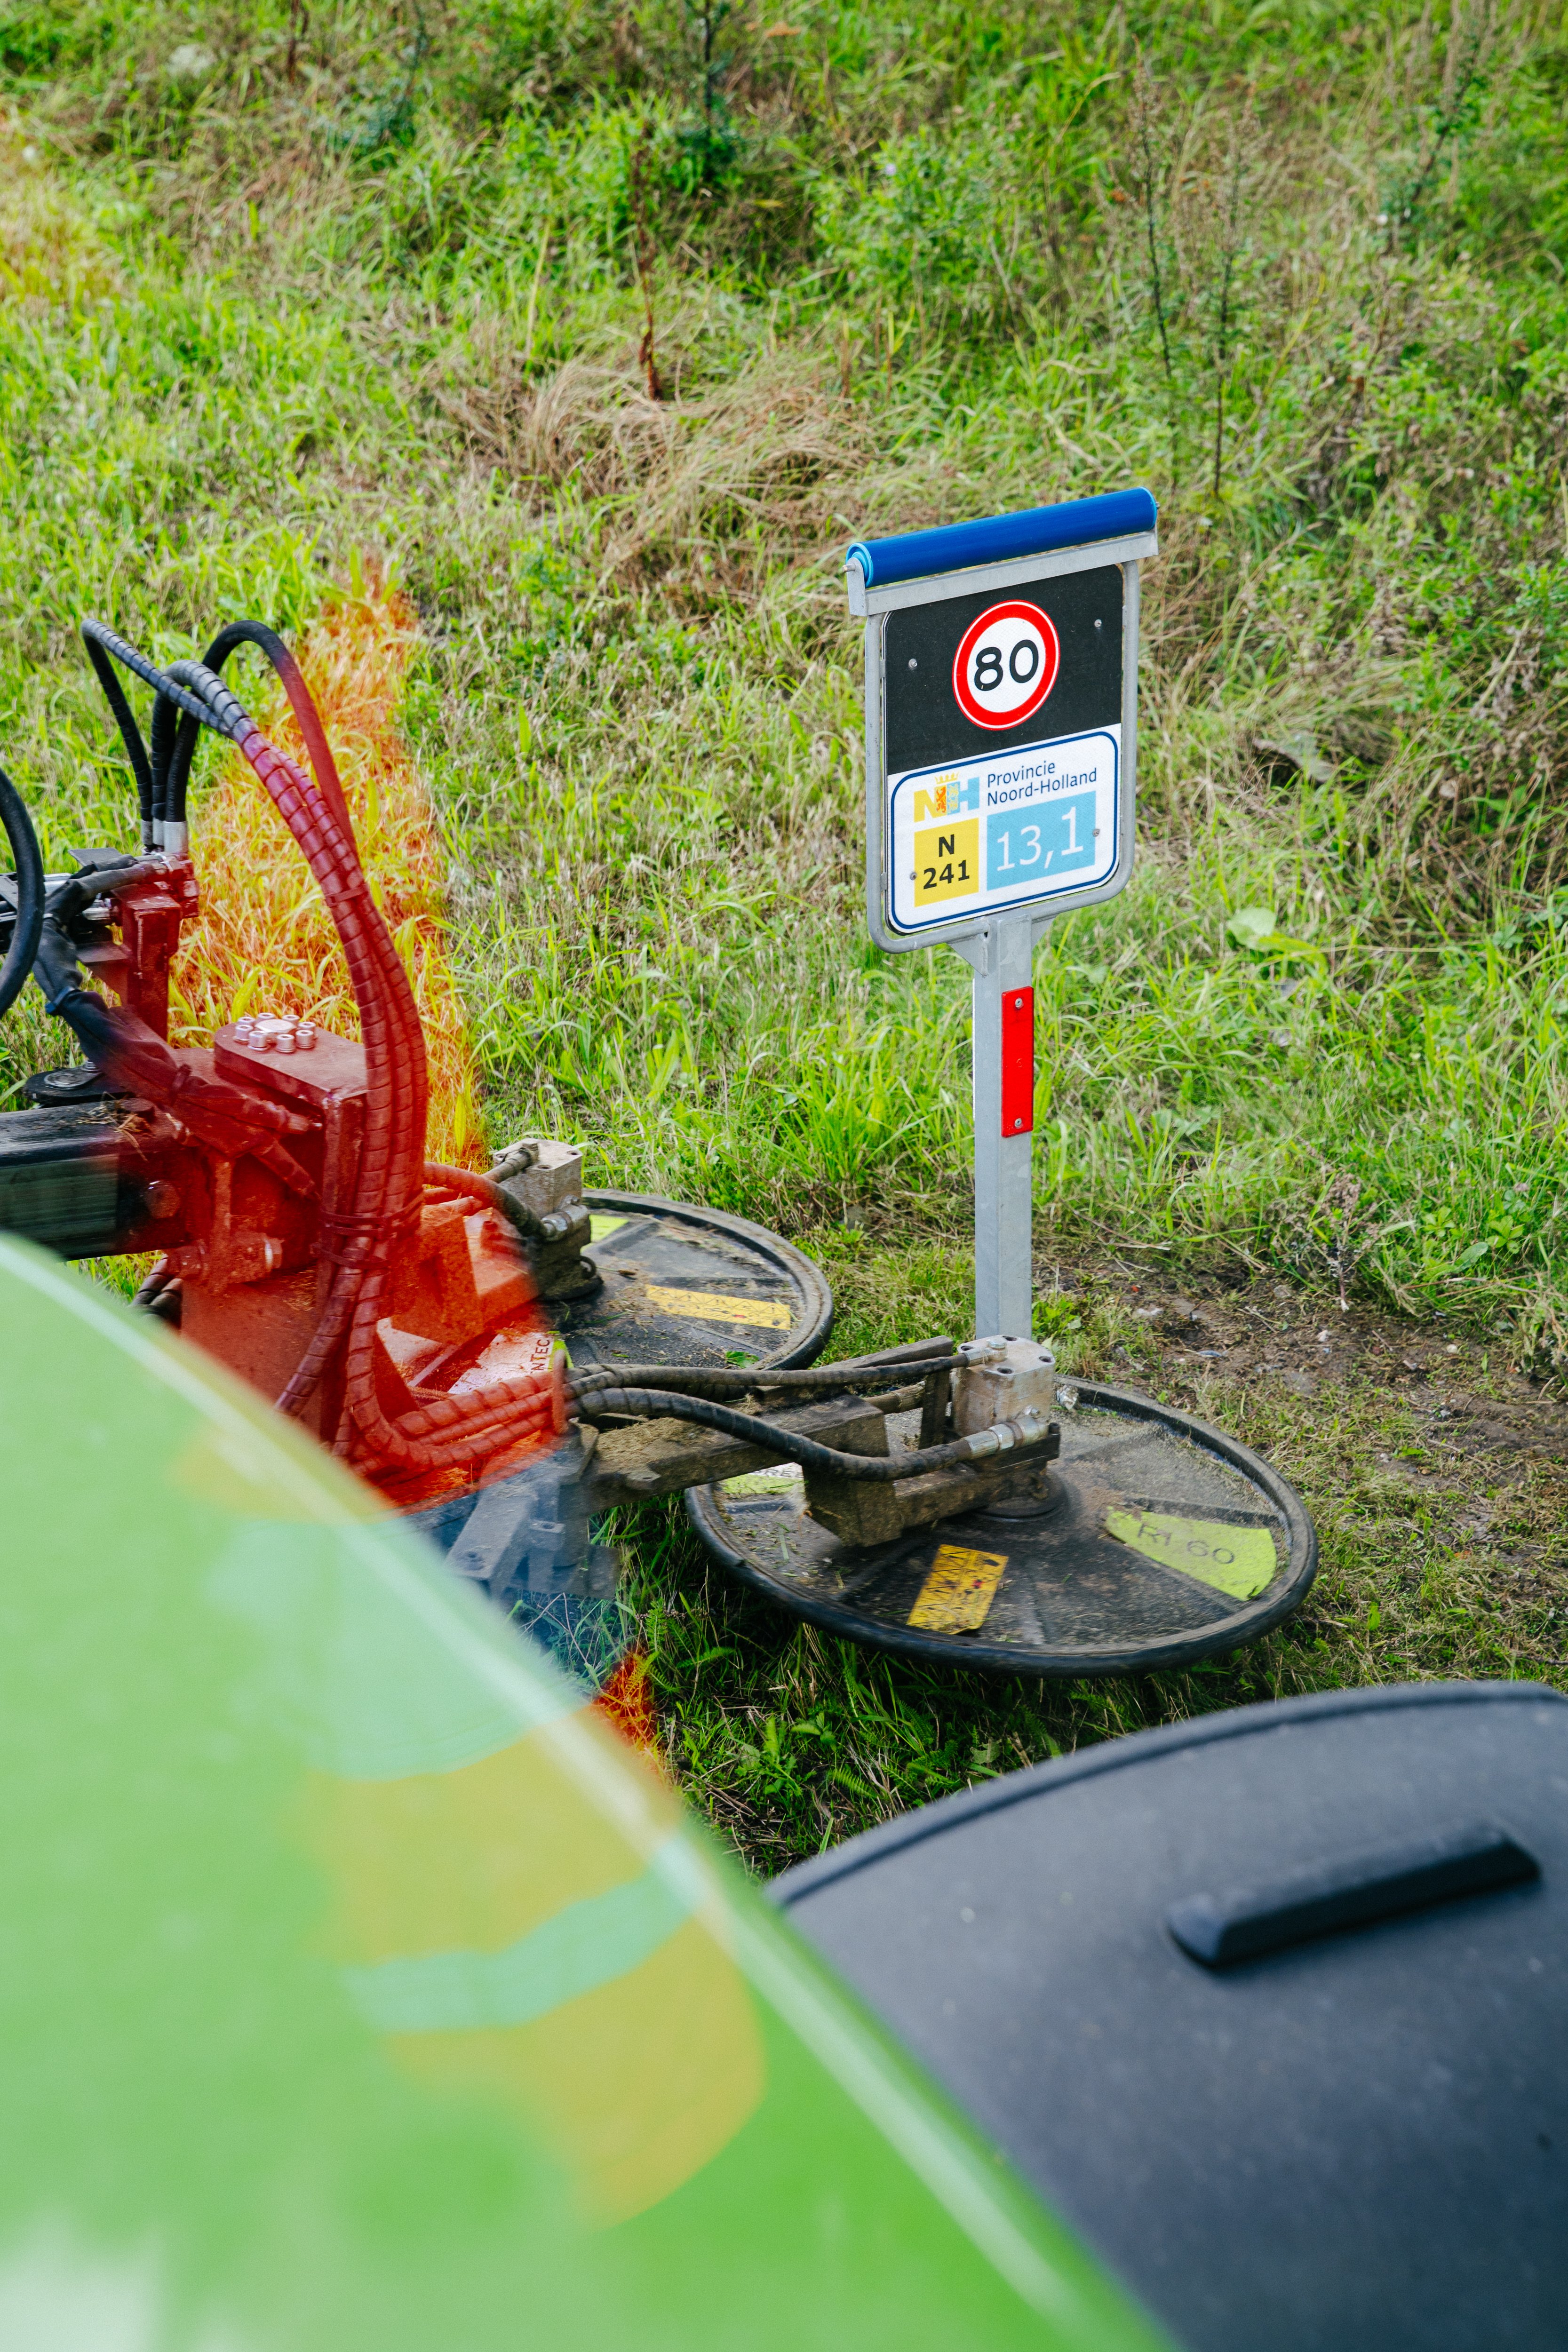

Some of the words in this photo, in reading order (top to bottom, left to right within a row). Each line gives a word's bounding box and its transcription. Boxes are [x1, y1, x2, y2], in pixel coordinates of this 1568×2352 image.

[974, 639, 1039, 691] 80
[987, 761, 1056, 787] Provincie
[987, 768, 1097, 806] Noord-Holland
[939, 834, 955, 858] N
[996, 806, 1084, 871] 13,1
[923, 859, 970, 890] 241
[530, 1339, 550, 1374] NTEC
